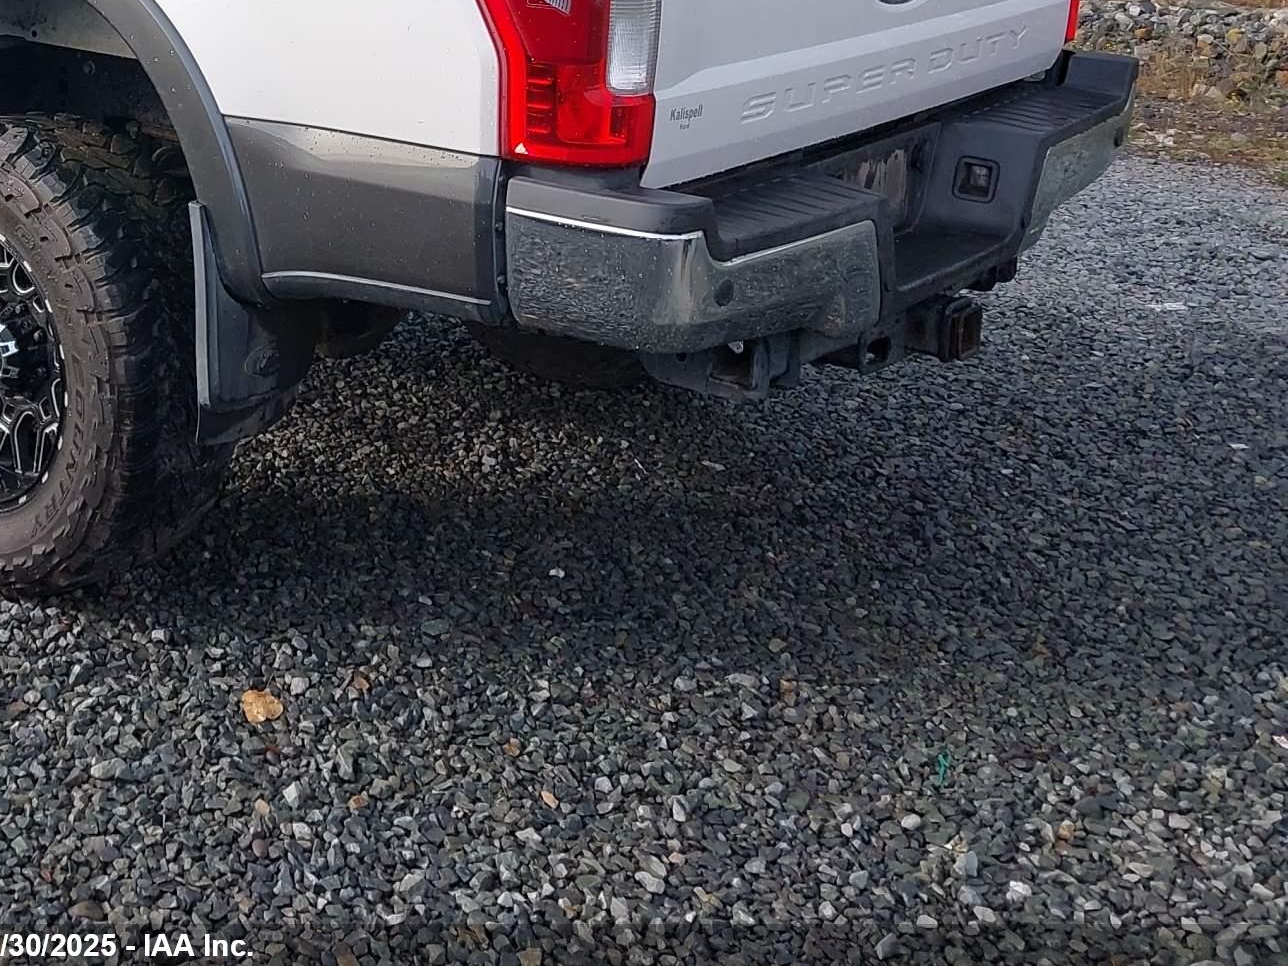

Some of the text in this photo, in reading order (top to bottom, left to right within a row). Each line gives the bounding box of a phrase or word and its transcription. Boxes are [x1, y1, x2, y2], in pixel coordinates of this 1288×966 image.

[740, 25, 1028, 124] SUPER DUTY
[669, 104, 703, 122] Kalispell
